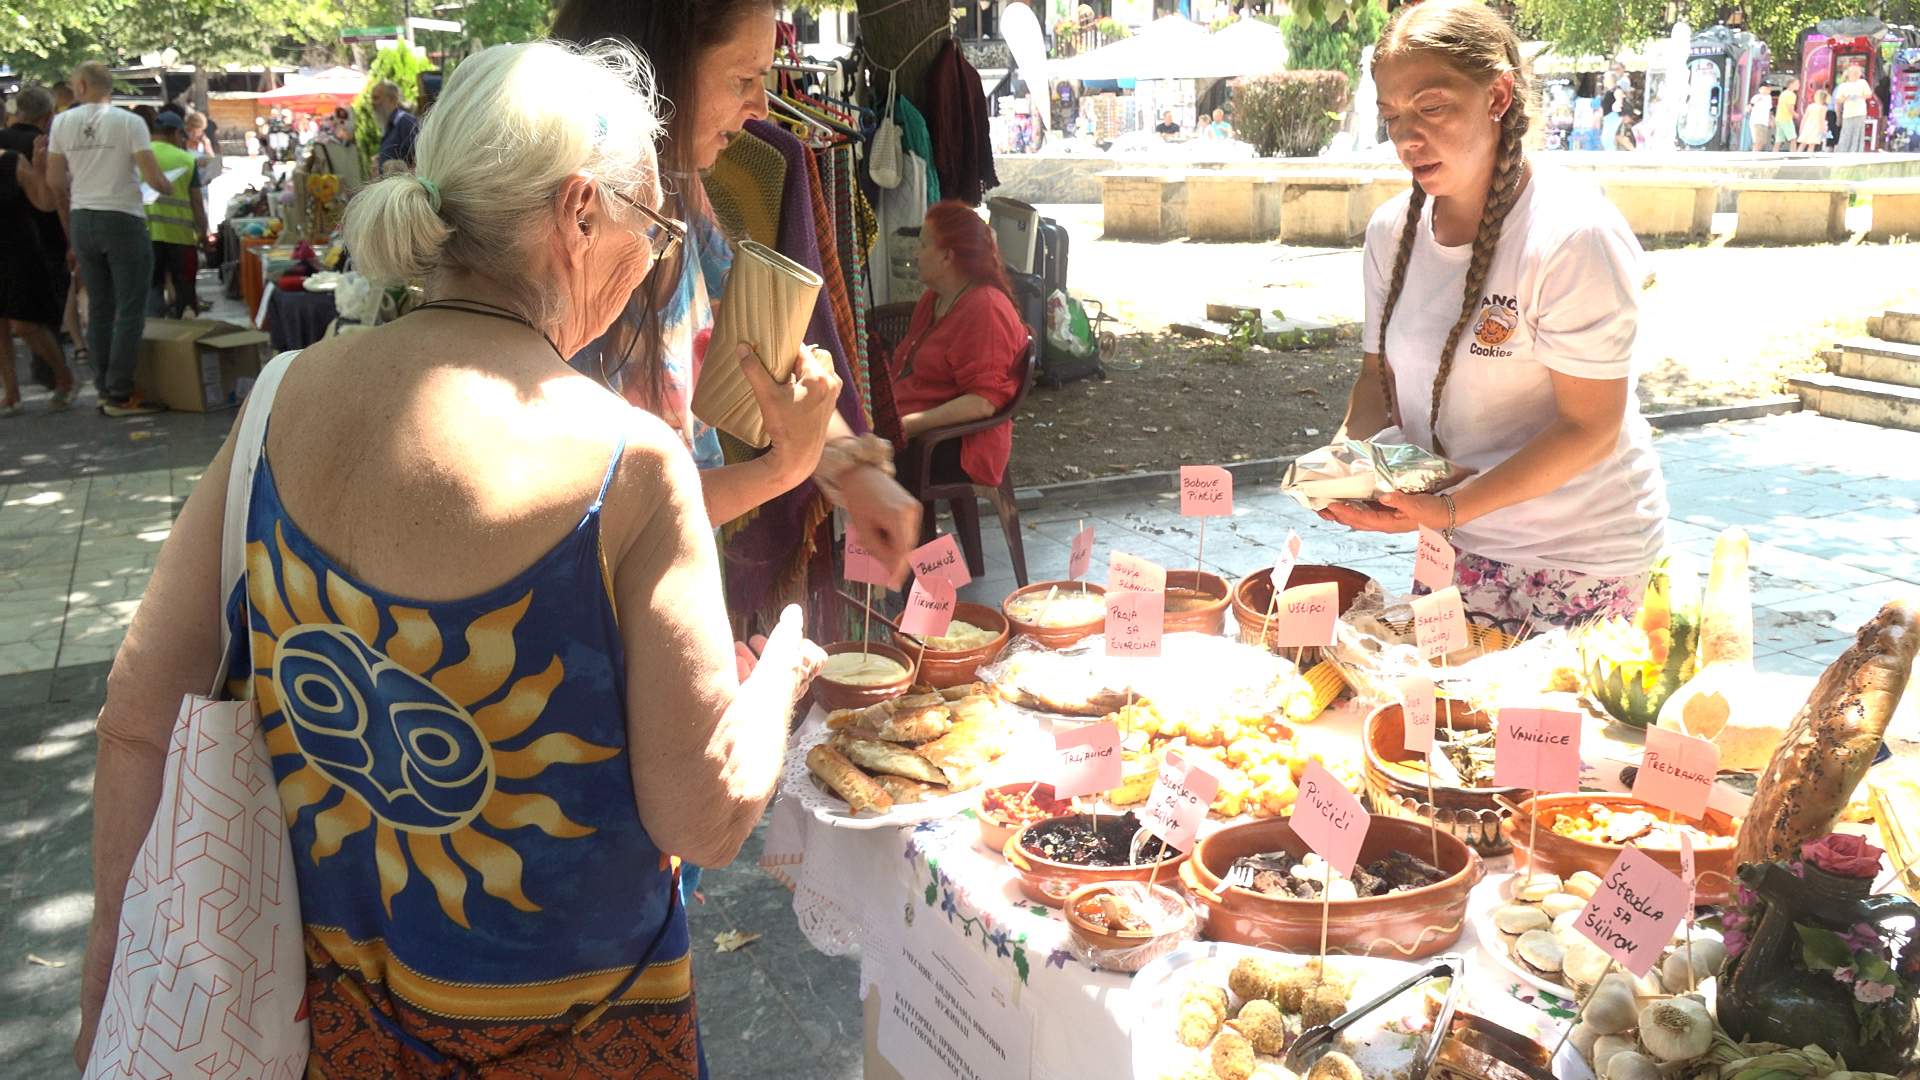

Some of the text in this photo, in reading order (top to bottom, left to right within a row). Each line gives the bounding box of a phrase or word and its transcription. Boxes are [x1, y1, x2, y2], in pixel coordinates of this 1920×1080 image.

[1470, 342, 1513, 358] Cookies
[1113, 563, 1140, 579] SUVA
[1126, 625, 1139, 639] SA
[1510, 725, 1570, 745] VANILICE
[1613, 906, 1632, 925] SA
[902, 947, 935, 985] УЧЕСНИК:
